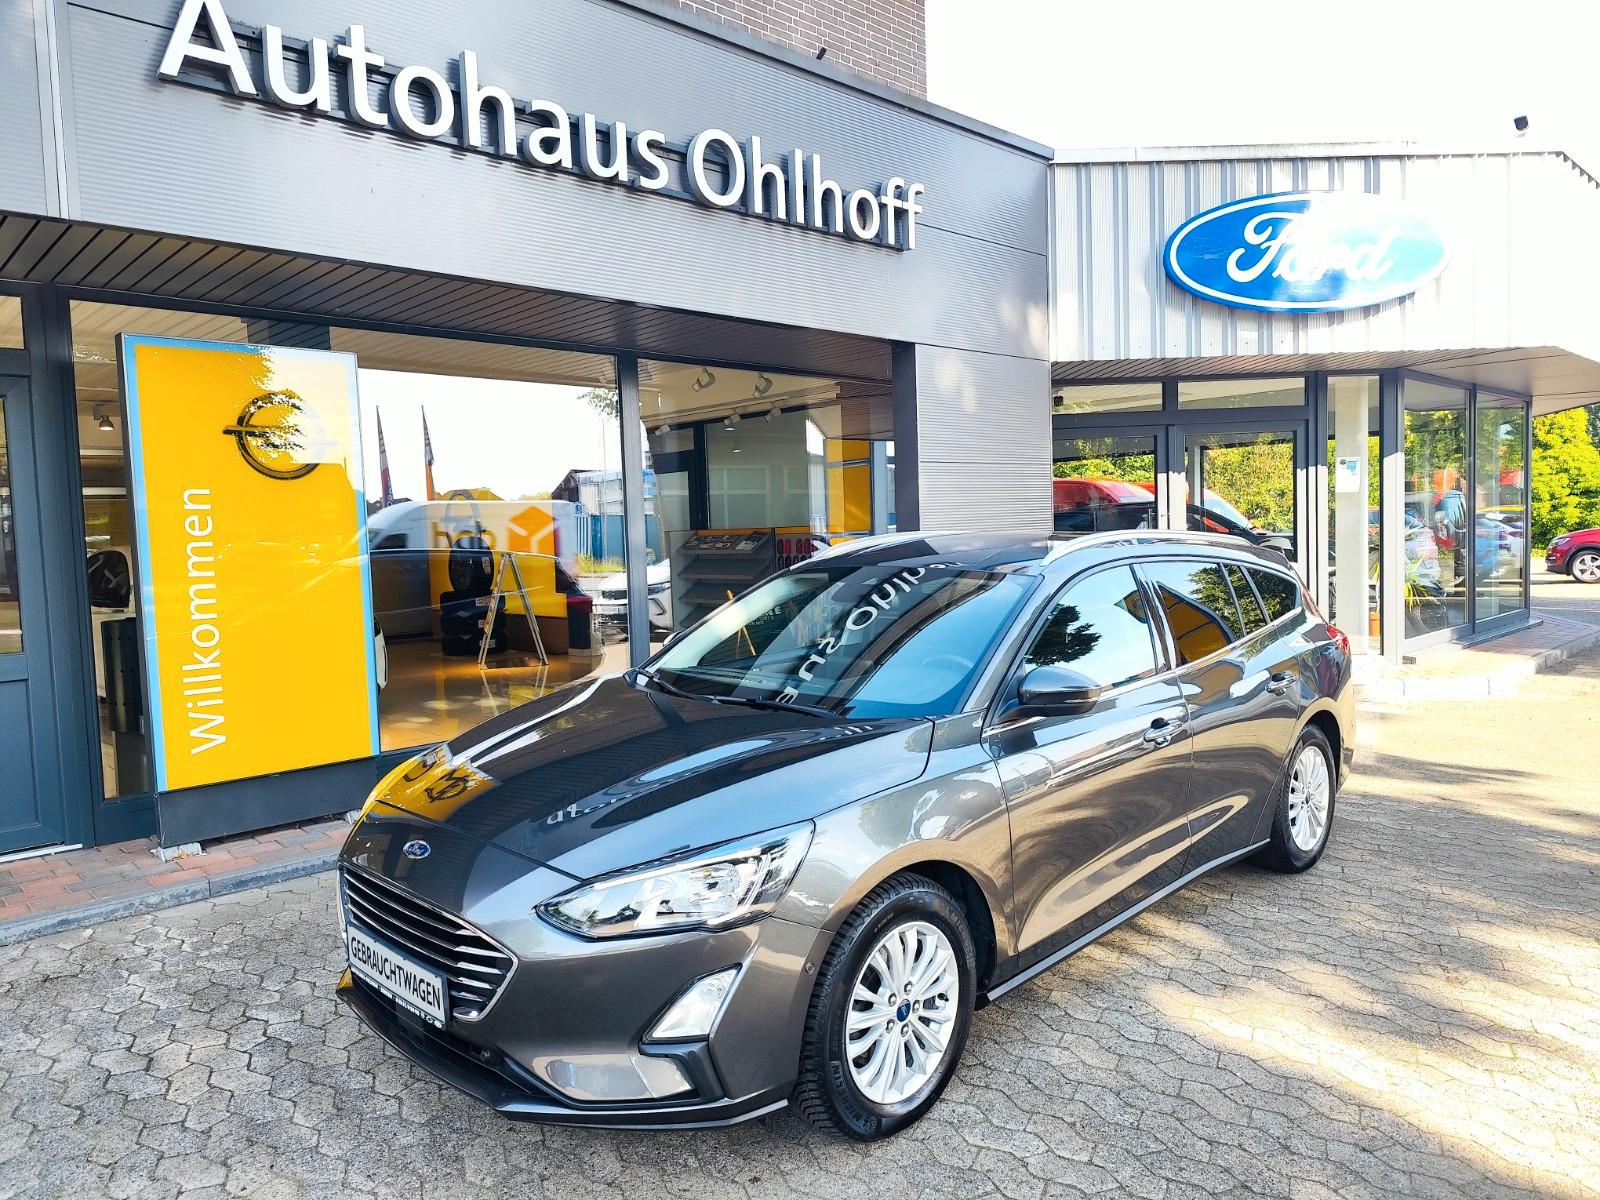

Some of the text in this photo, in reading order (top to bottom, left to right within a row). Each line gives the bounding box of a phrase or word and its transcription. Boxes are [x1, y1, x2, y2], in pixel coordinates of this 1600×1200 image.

[157, 0, 925, 250] Autohaus Ohlhoff
[182, 487, 227, 755] Willkommen
[350, 936, 442, 1011] GEBRAUCHTWAGEN
